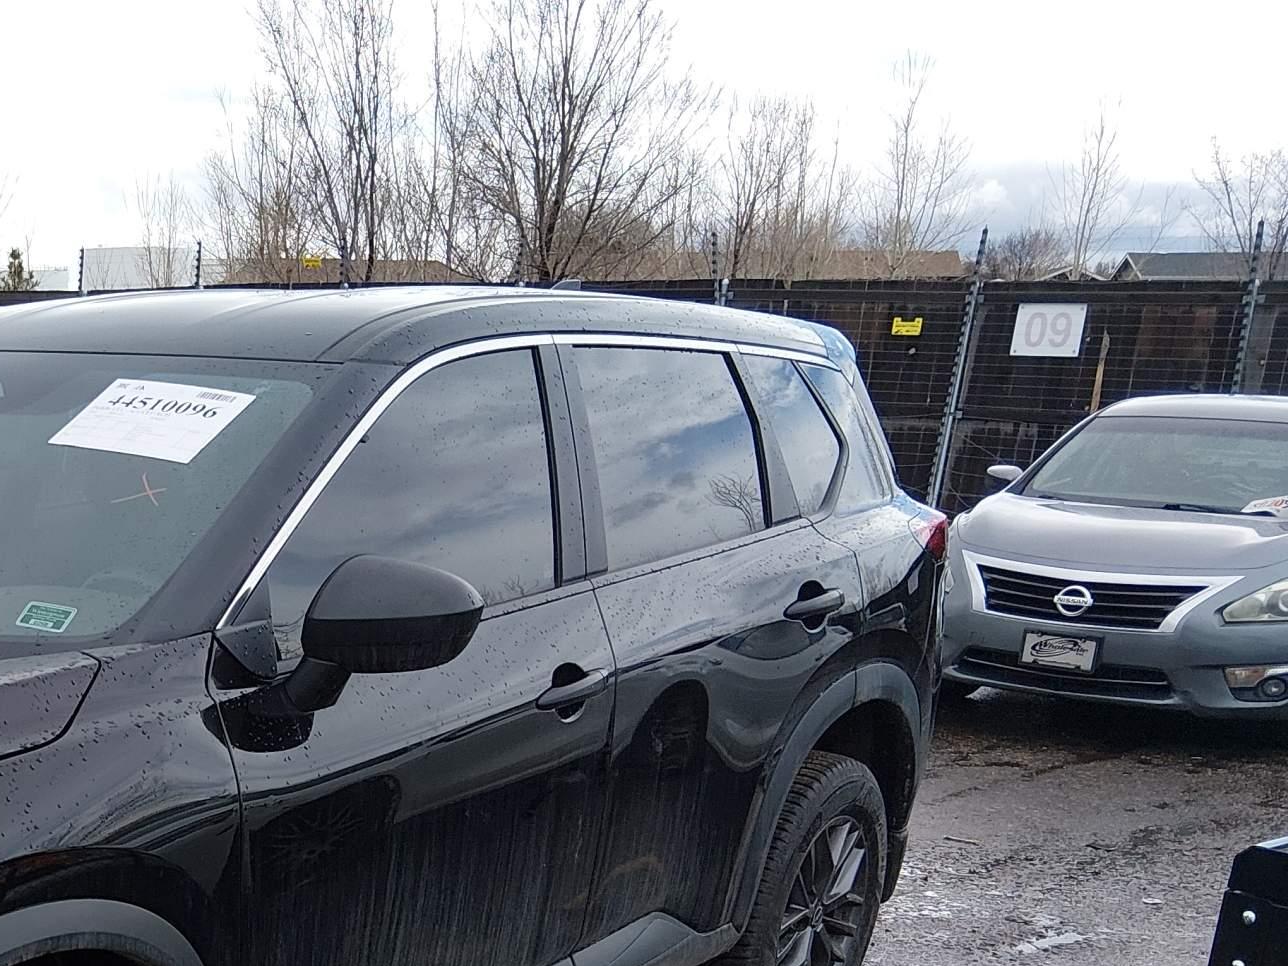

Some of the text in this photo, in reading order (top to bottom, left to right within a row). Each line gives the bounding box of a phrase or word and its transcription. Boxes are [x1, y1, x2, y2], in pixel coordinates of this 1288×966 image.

[1024, 312, 1072, 348] 09
[109, 394, 223, 419] 44510096
[1056, 597, 1088, 605] NISSAN
